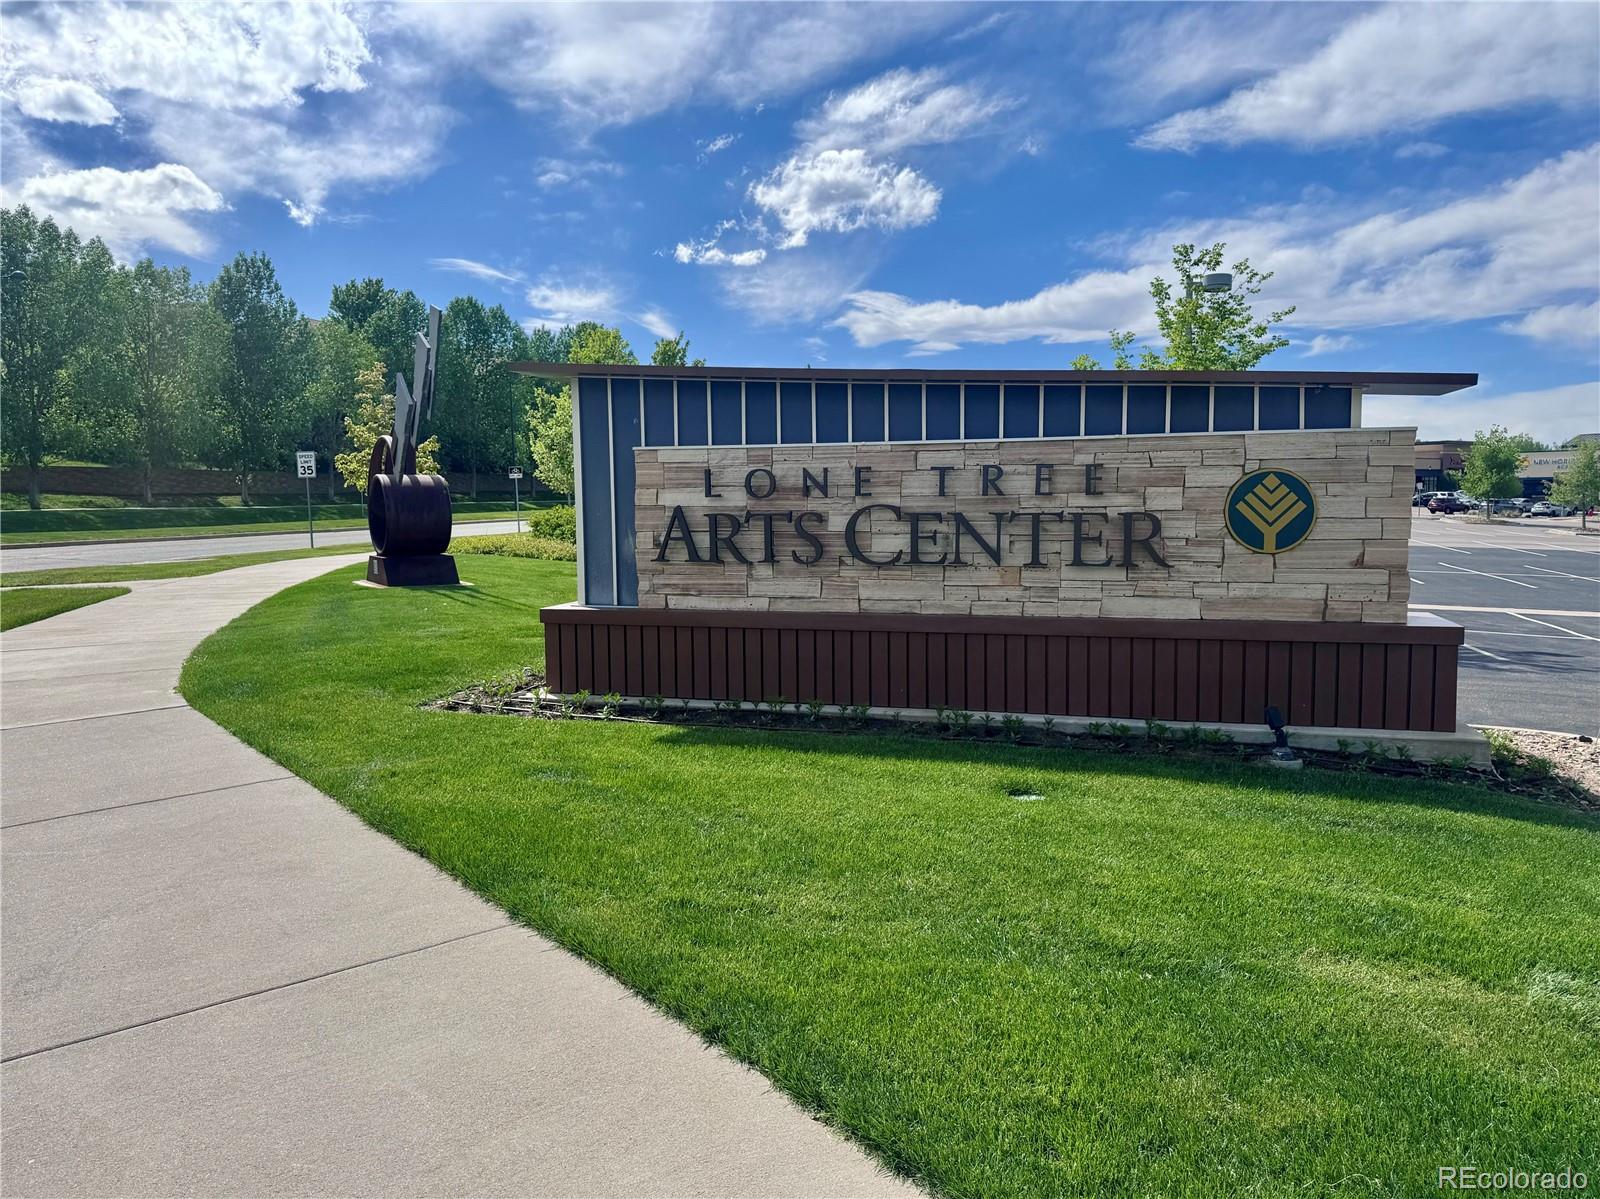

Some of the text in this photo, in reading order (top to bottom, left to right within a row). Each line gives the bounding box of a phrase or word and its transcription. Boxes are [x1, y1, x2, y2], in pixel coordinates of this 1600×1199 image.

[300, 465, 313, 475] 35
[703, 463, 1105, 499] LONE TREE
[656, 503, 1174, 569] ARTS CENTER
